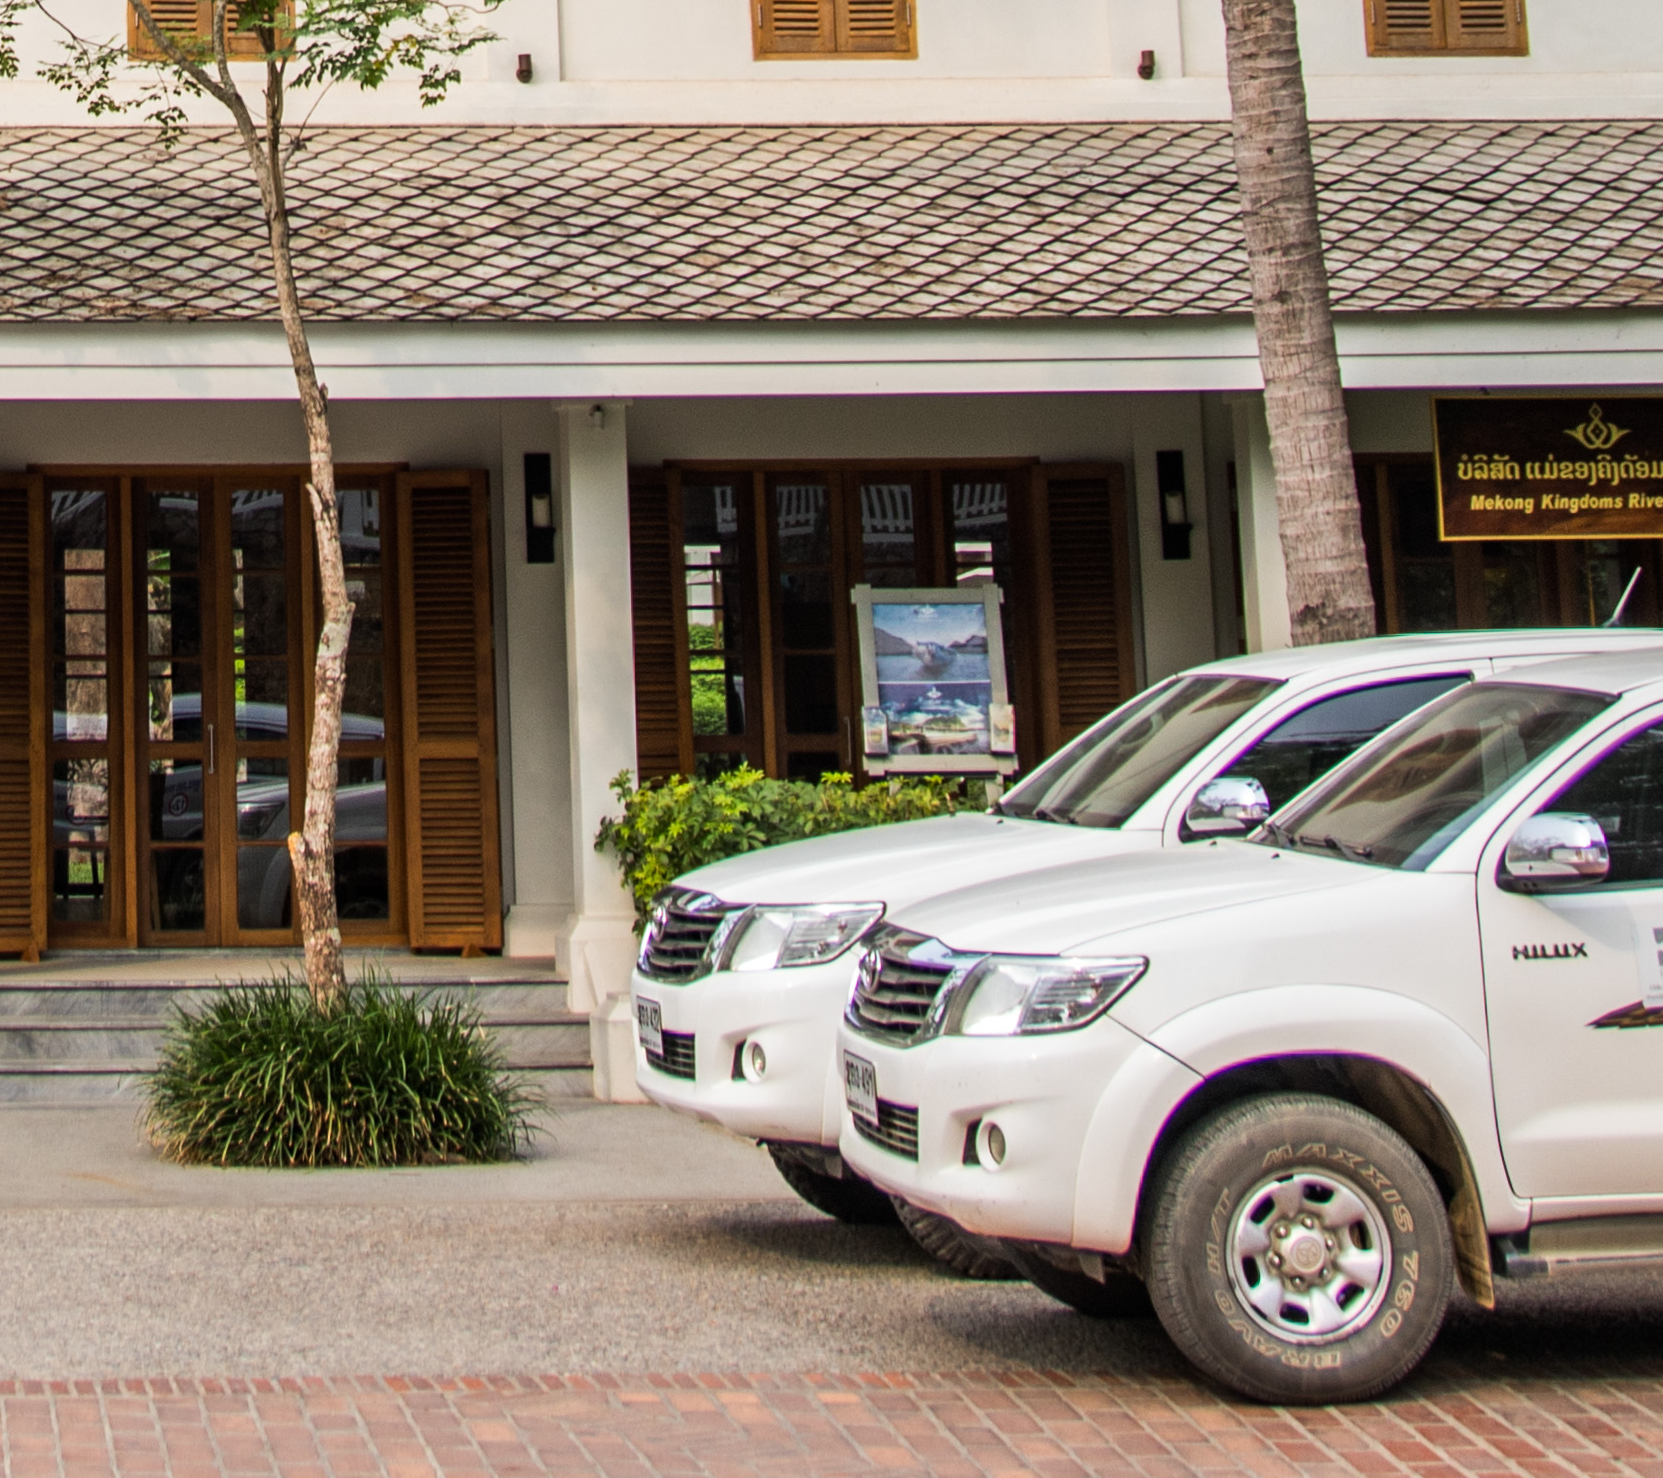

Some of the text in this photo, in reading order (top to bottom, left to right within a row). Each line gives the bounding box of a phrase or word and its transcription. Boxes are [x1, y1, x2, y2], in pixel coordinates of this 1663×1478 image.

[1470, 495, 1534, 514] Mekong
[1541, 494, 1623, 513] Kingdoms
[1512, 942, 1588, 960] HILUX
[1262, 1143, 1420, 1338] MAXXIS 760
[1214, 1290, 1342, 1370] BRAVO
